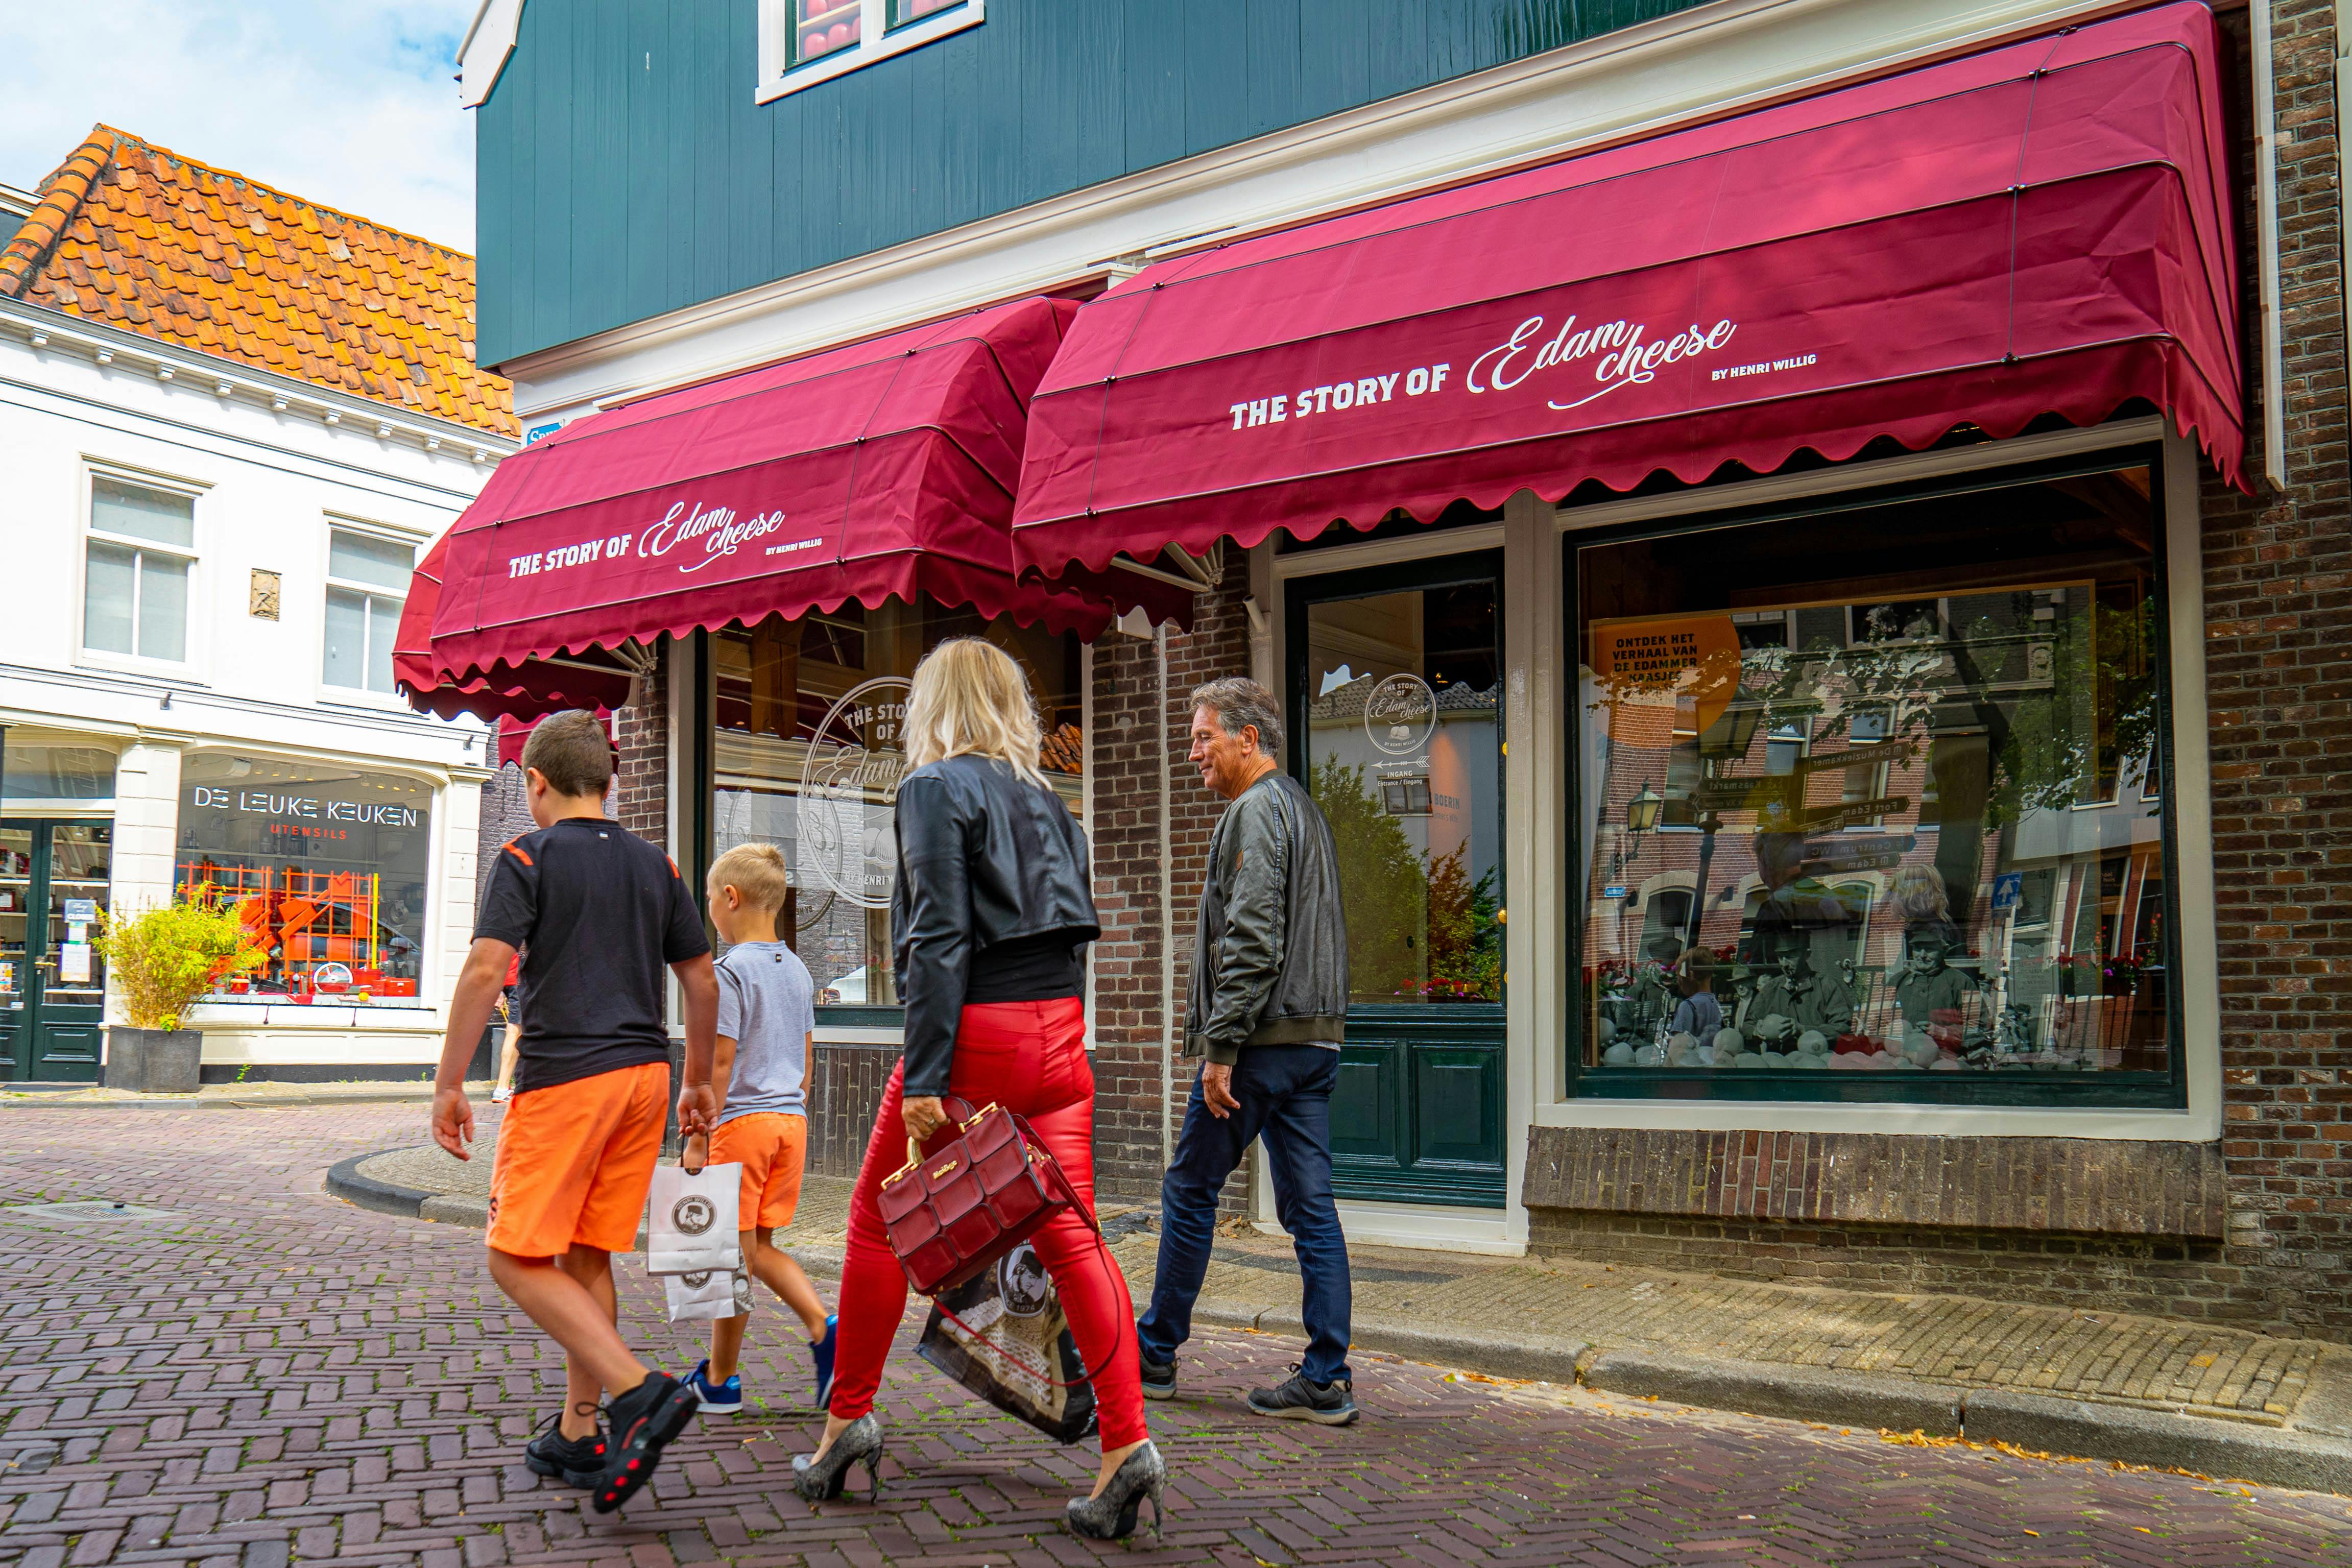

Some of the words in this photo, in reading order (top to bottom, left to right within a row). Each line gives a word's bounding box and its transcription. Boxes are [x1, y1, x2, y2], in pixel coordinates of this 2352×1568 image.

[1230, 395, 1288, 430] THE
[1295, 372, 1400, 418] STORY
[1405, 363, 1450, 396] OF
[1466, 315, 1634, 394] Edam
[1548, 319, 1737, 410] cheese
[1712, 371, 1729, 381] BY
[1730, 364, 1769, 378] HENRI
[1773, 354, 1816, 371] WILLIG
[509, 553, 543, 578] THE
[544, 539, 605, 571] STORY
[606, 534, 632, 558] OF
[638, 501, 730, 558] Edam
[679, 511, 785, 573] cheese
[765, 547, 776, 556] BY
[776, 543, 798, 554] HENRI
[799, 538, 823, 551] WILLIG
[1616, 636, 1667, 648] ONTDEK
[1671, 633, 1695, 644] HET
[1613, 647, 1669, 660] VERHAAL
[1673, 645, 1697, 656] VAN
[1614, 663, 1629, 672] DE
[1634, 658, 1697, 671] EDAMMER
[1383, 684, 1396, 693] THE
[845, 707, 874, 730] THE
[877, 704, 906, 720] STO
[1369, 698, 1407, 718] Edam
[1389, 704, 1431, 725] cheese
[877, 723, 896, 740] OF
[811, 746, 902, 799] Edam
[1387, 770, 1413, 778] INGANG
[195, 786, 229, 808] DE
[240, 792, 318, 818] LEUKE
[327, 800, 417, 827] KEUKEN
[1434, 793, 1460, 810] BOERIN
[271, 824, 347, 839] UTENSILS
[858, 874, 885, 886] HENRI
